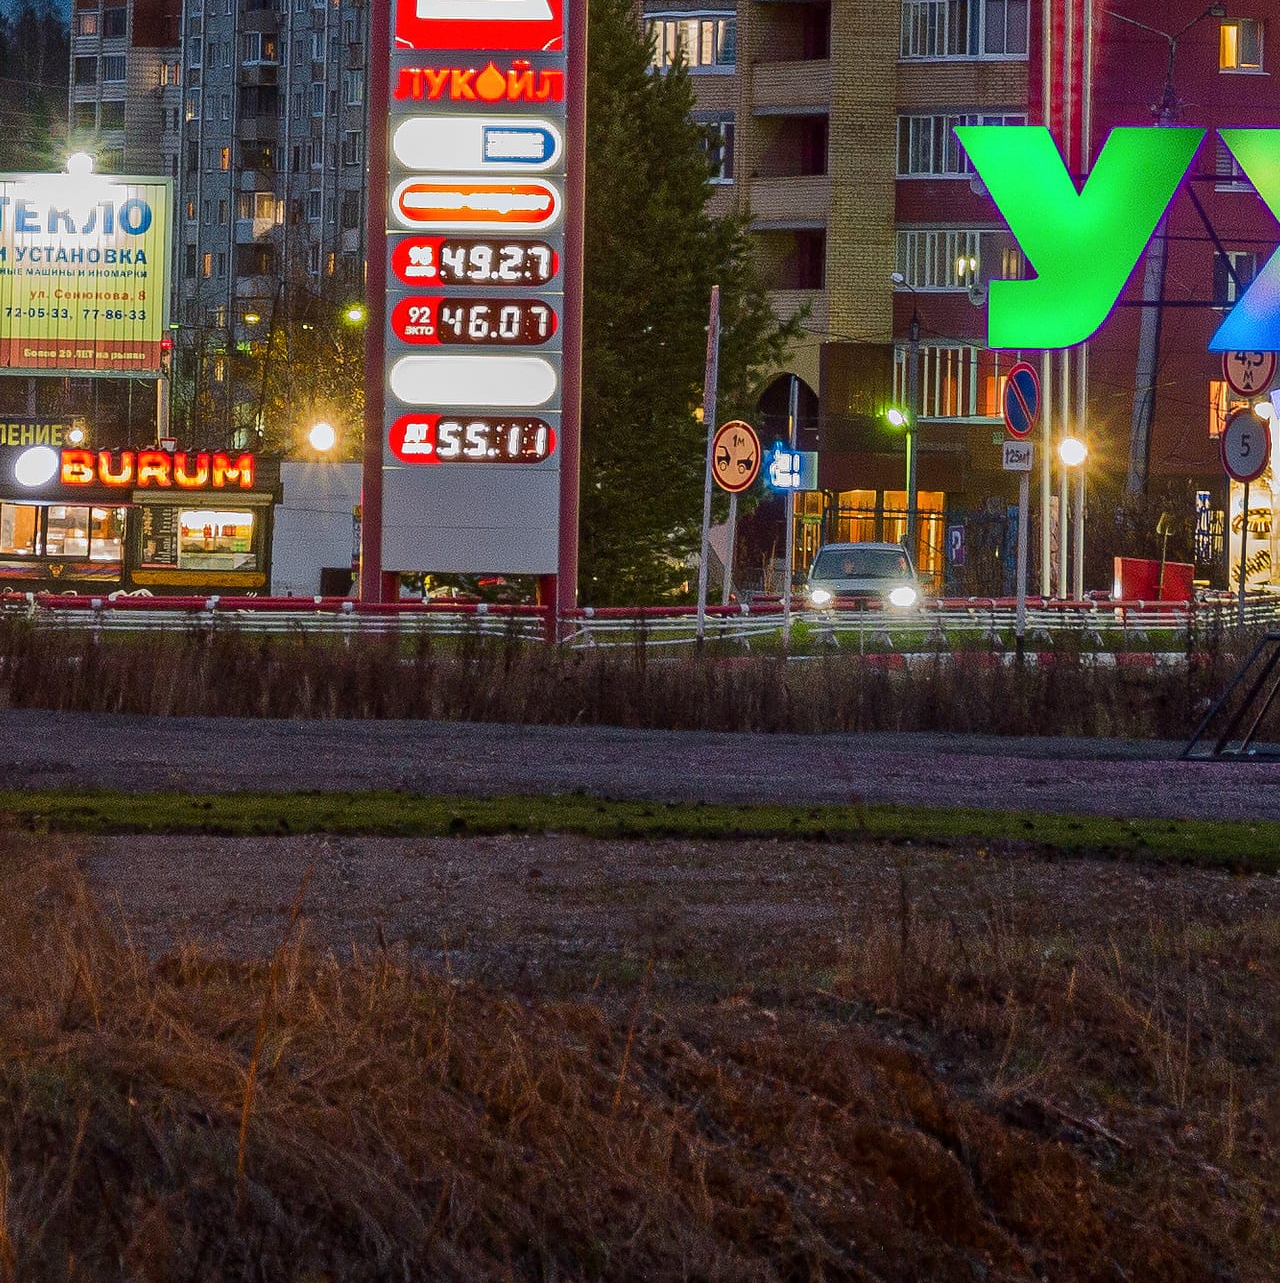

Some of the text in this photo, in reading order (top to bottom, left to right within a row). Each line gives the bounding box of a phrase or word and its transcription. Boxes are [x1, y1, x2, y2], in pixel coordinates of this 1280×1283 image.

[15, 246, 148, 265] УСТАНОВКА
[26, 268, 76, 278] МАШИНЫ
[88, 269, 148, 279] ИНОМАРКИ
[138, 289, 147, 302] 8
[83, 309, 147, 322] 77-86-33
[408, 306, 431, 324] 92
[1240, 434, 1251, 458] 5
[60, 449, 255, 488] BURUM
